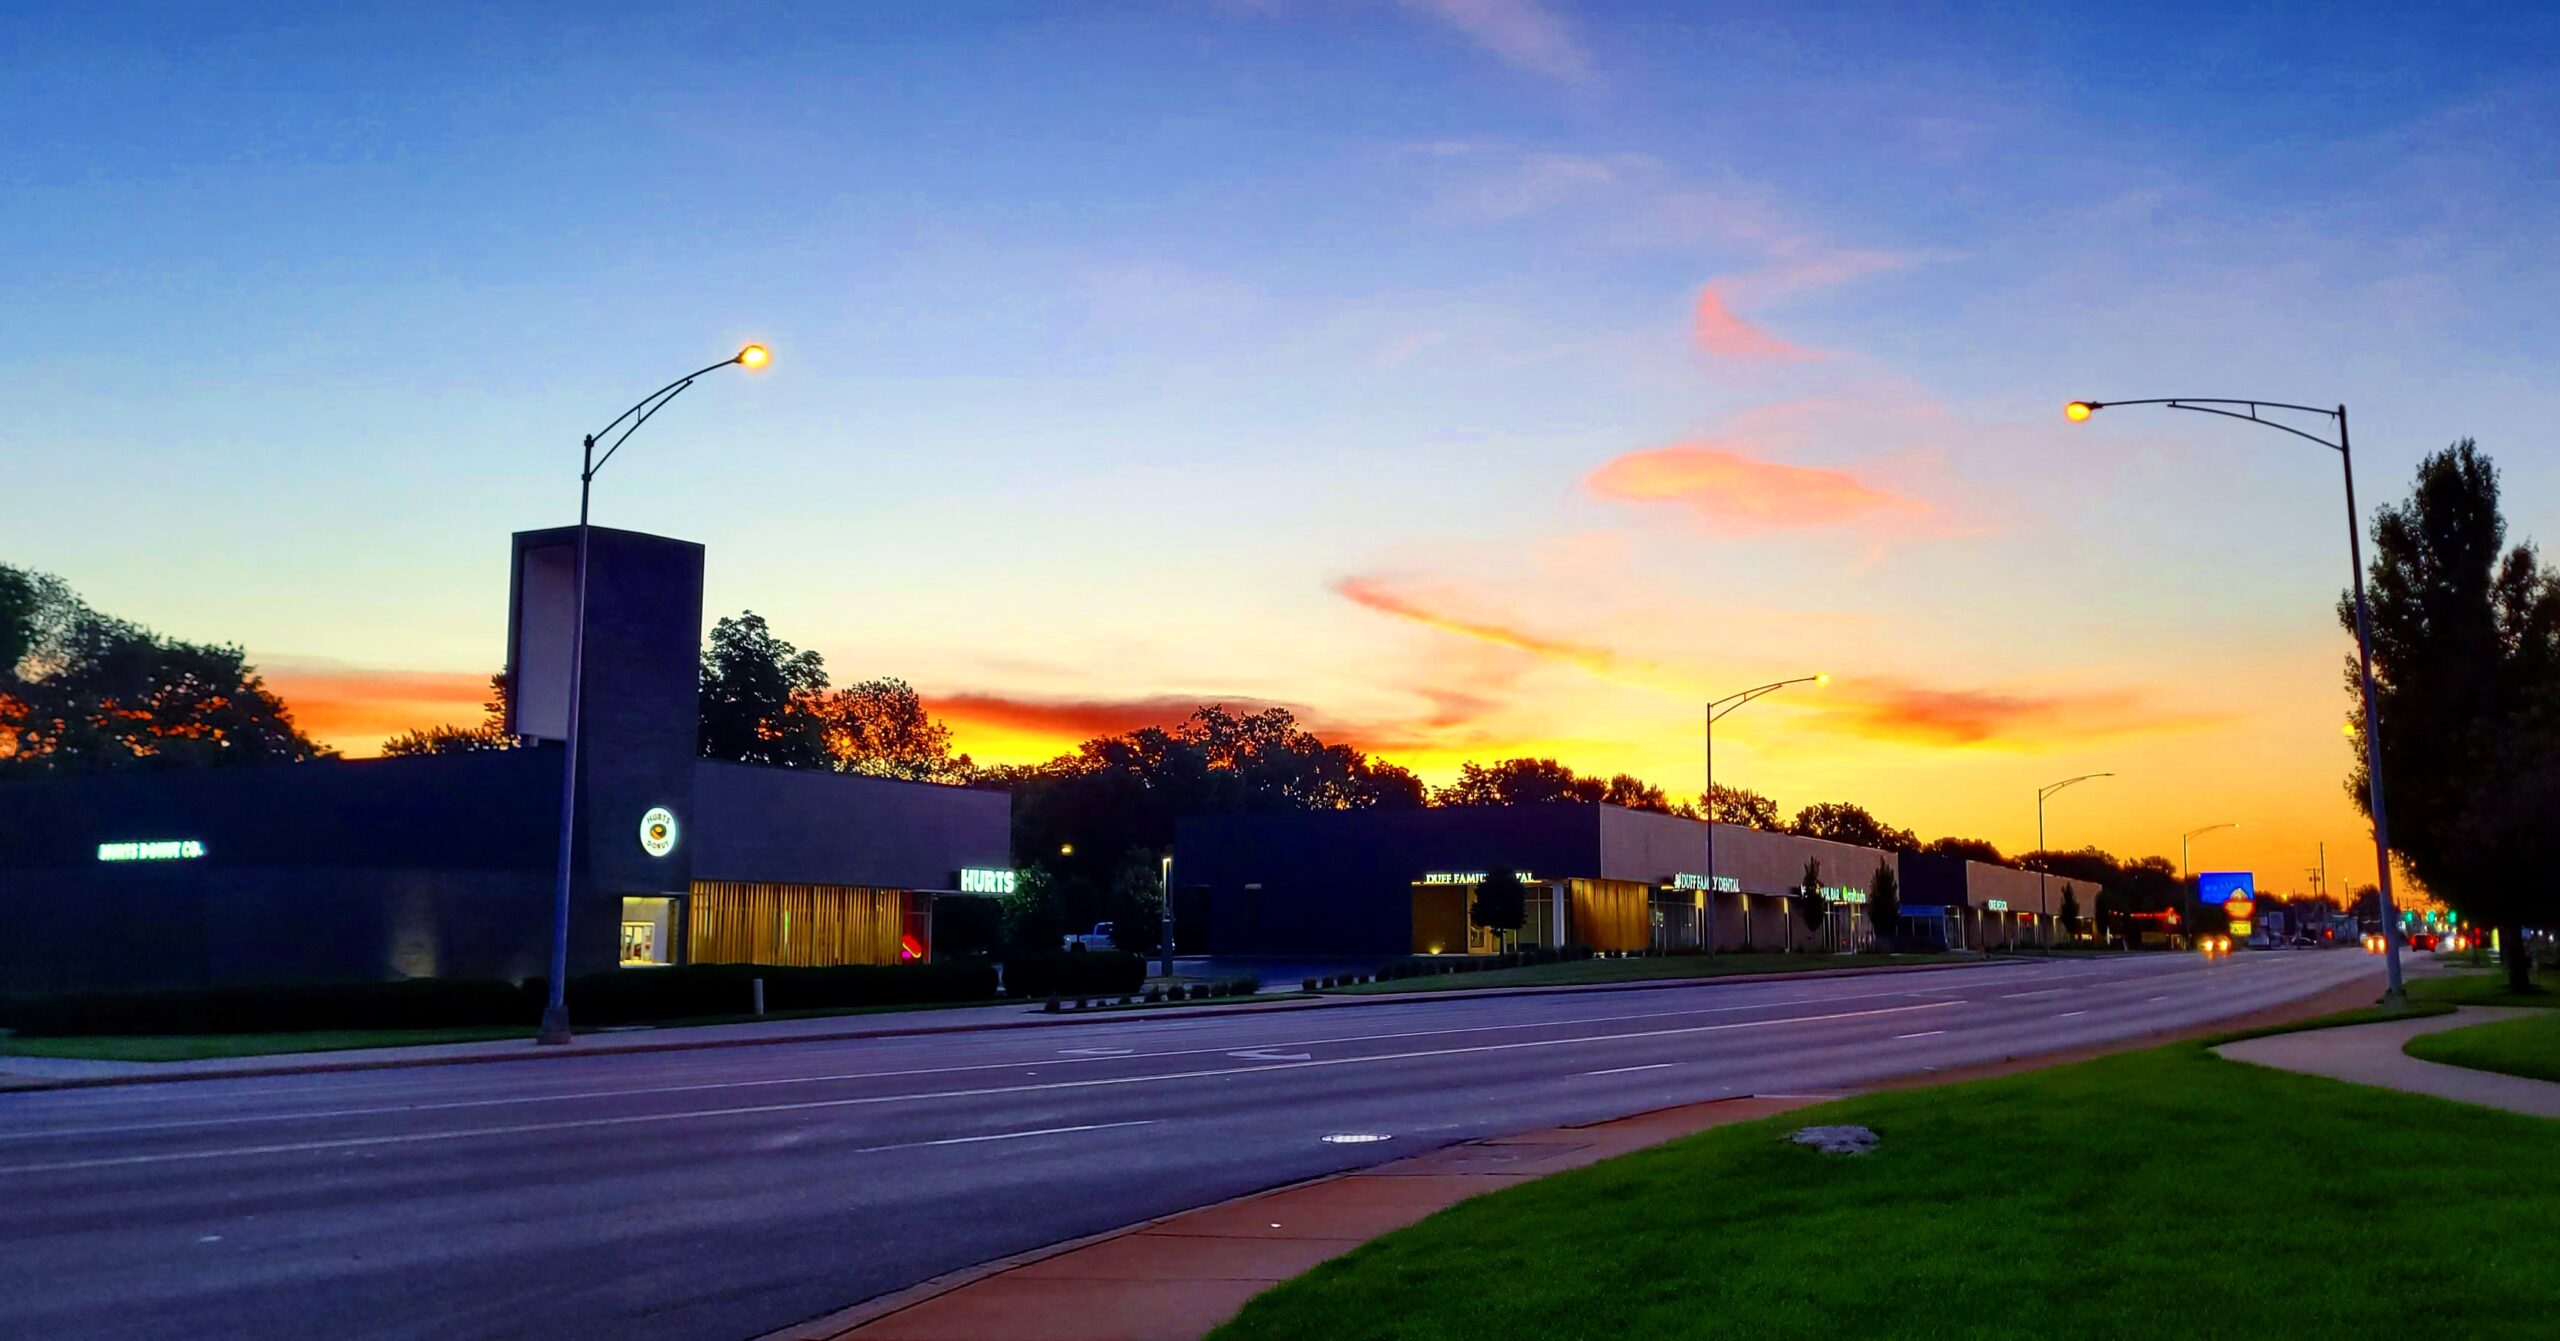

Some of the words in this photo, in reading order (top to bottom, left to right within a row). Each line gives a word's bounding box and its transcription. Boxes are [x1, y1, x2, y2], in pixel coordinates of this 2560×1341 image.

[647, 813, 670, 824] HURTS
[647, 840, 669, 849] DONUT
[960, 869, 1015, 893] HURTS
[1426, 873, 1452, 884] DUFF
[1681, 873, 1696, 889] DUFF
[1718, 876, 1740, 893] DENTAL
